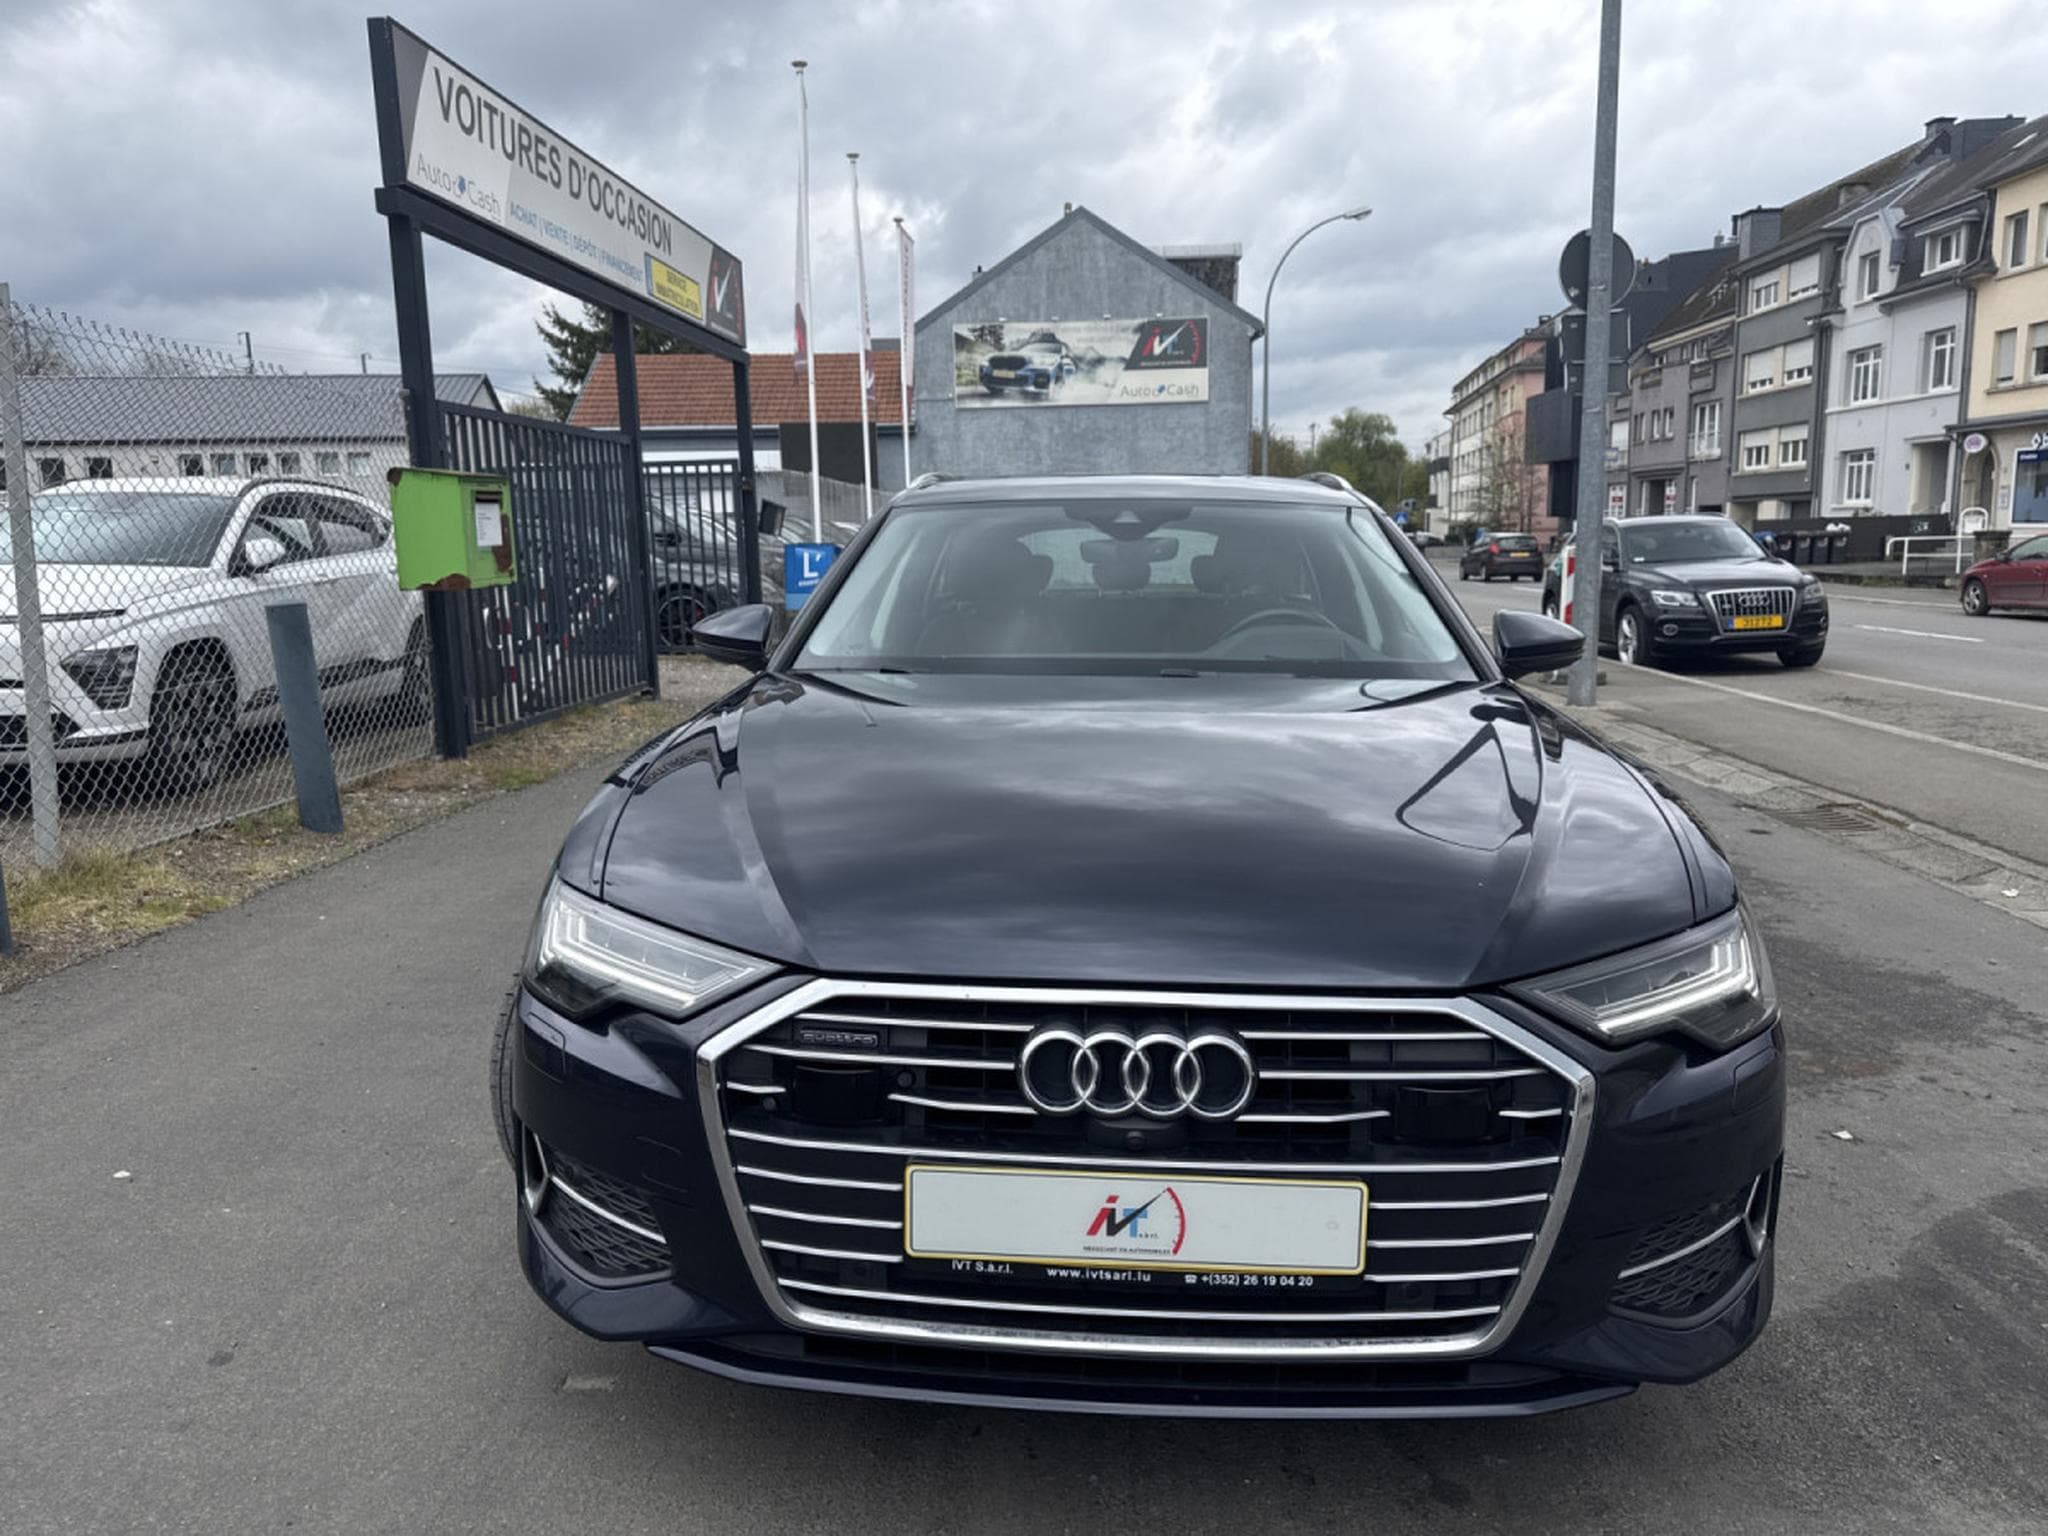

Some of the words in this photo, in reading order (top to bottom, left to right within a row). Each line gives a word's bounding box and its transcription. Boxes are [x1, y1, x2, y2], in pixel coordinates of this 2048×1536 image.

[433, 66, 562, 190] VOITURES
[567, 156, 672, 257] D'OCCASION
[416, 151, 452, 192] Auto
[466, 178, 503, 217] Cash
[1119, 384, 1152, 397] Auto
[1167, 383, 1199, 397] Cash
[951, 1259, 972, 1271] IVT
[1046, 1268, 1151, 1282] www.ivtsarl.lu
[1201, 1273, 1240, 1286] +(352)
[1243, 1274, 1259, 1286] 26
[1263, 1275, 1278, 1286] 19
[1280, 1276, 1295, 1287] 04
[1298, 1276, 1314, 1287] 20
